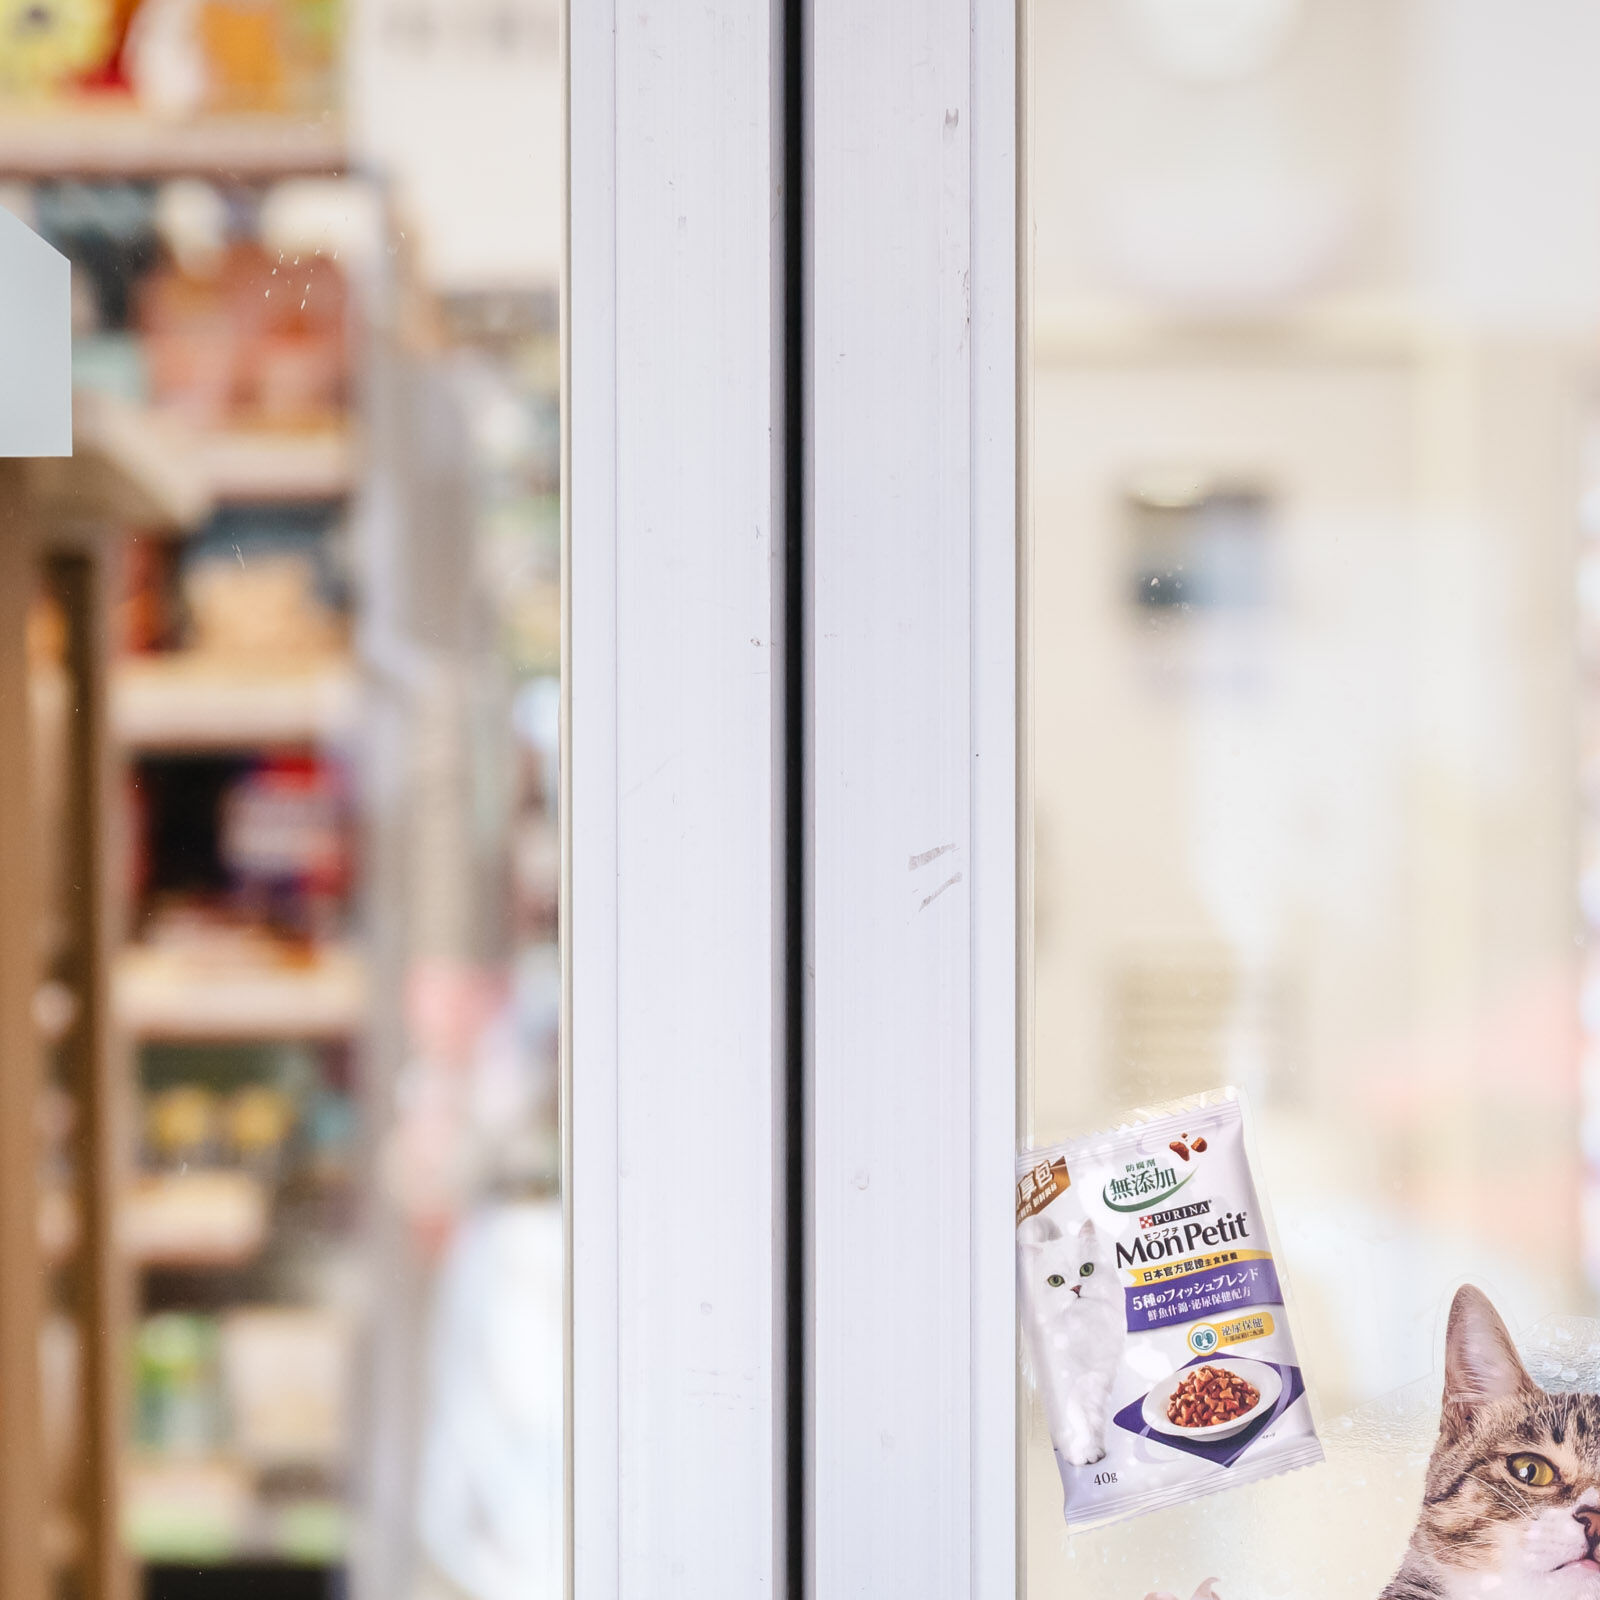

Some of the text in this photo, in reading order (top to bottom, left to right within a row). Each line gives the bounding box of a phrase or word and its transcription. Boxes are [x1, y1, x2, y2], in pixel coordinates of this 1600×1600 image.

[1016, 1160, 1054, 1211] 享包
[1109, 1167, 1178, 1202] 無添加
[1154, 1203, 1209, 1225] PURINA
[1144, 1227, 1179, 1242] モンプチ
[1132, 1268, 1260, 1311] 5種のフィッシュブレンド
[1093, 1469, 1118, 1488] 40g
